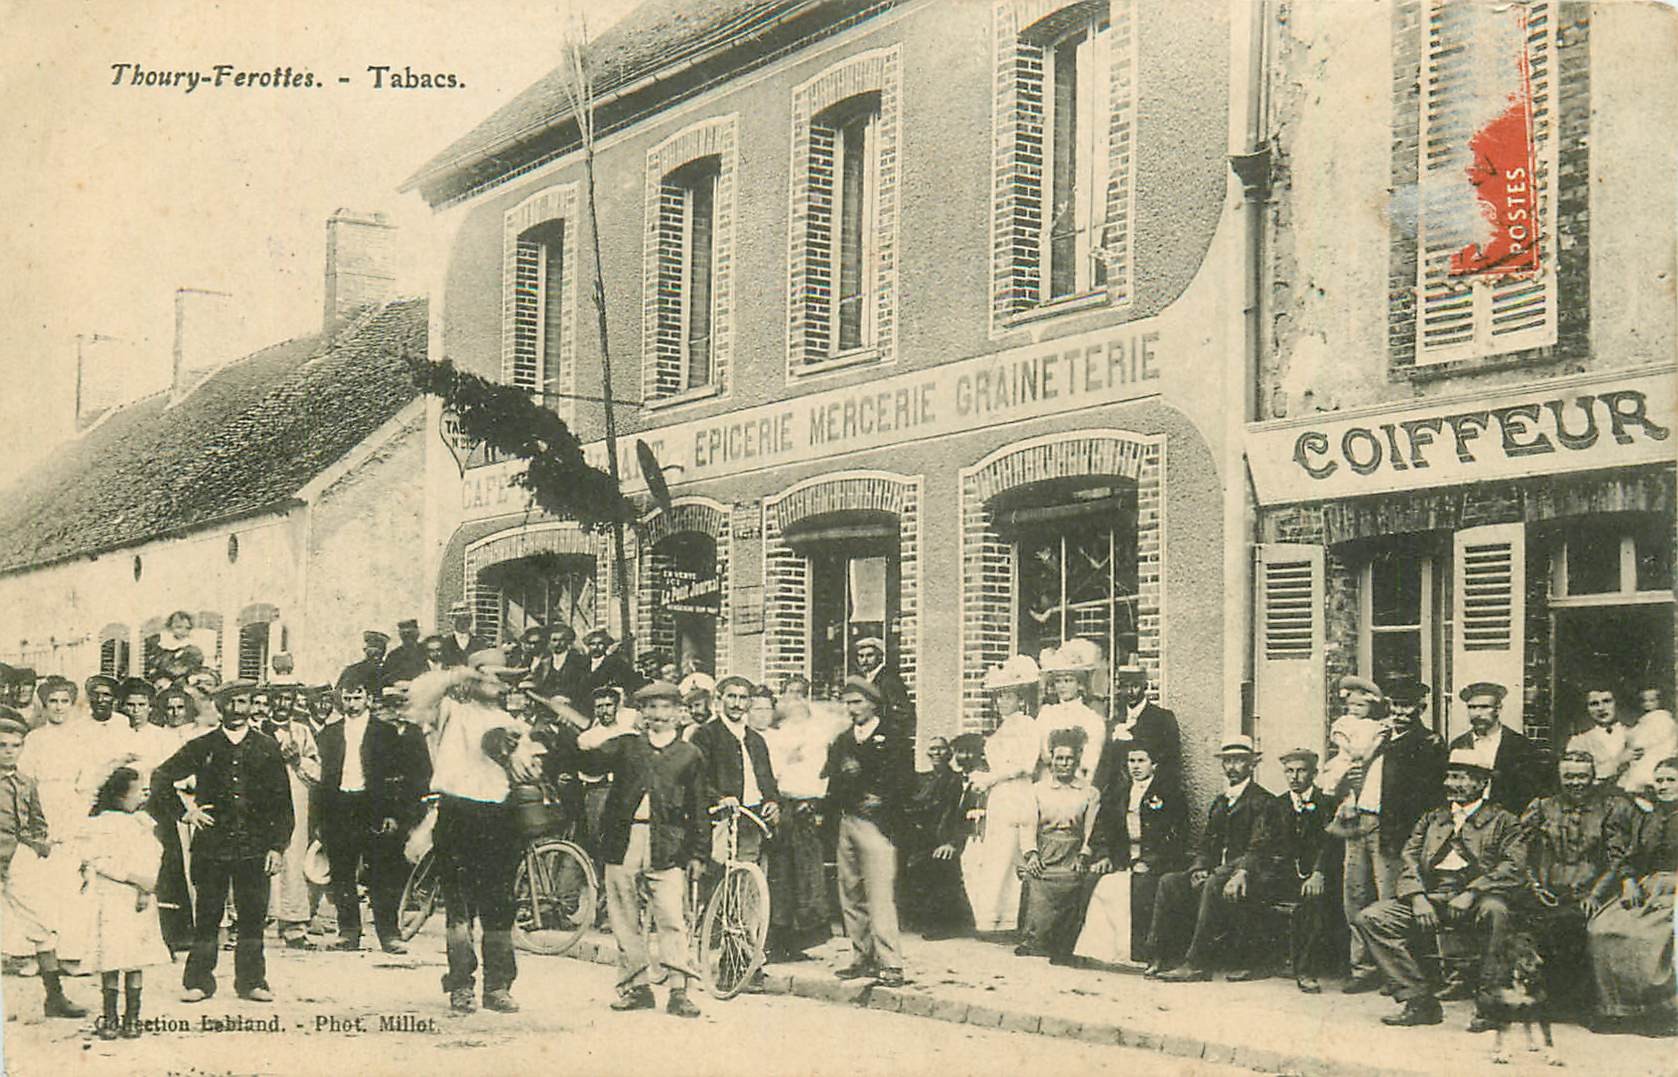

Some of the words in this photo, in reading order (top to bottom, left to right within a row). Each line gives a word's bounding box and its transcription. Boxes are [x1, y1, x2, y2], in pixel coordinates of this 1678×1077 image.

[1505, 167, 1527, 254] POSTES
[695, 412, 793, 467] EPICERIE
[810, 382, 936, 446] MERCERIE
[956, 331, 1160, 416] GRAINETERIE
[1292, 389, 1670, 480] COIFFEUR
